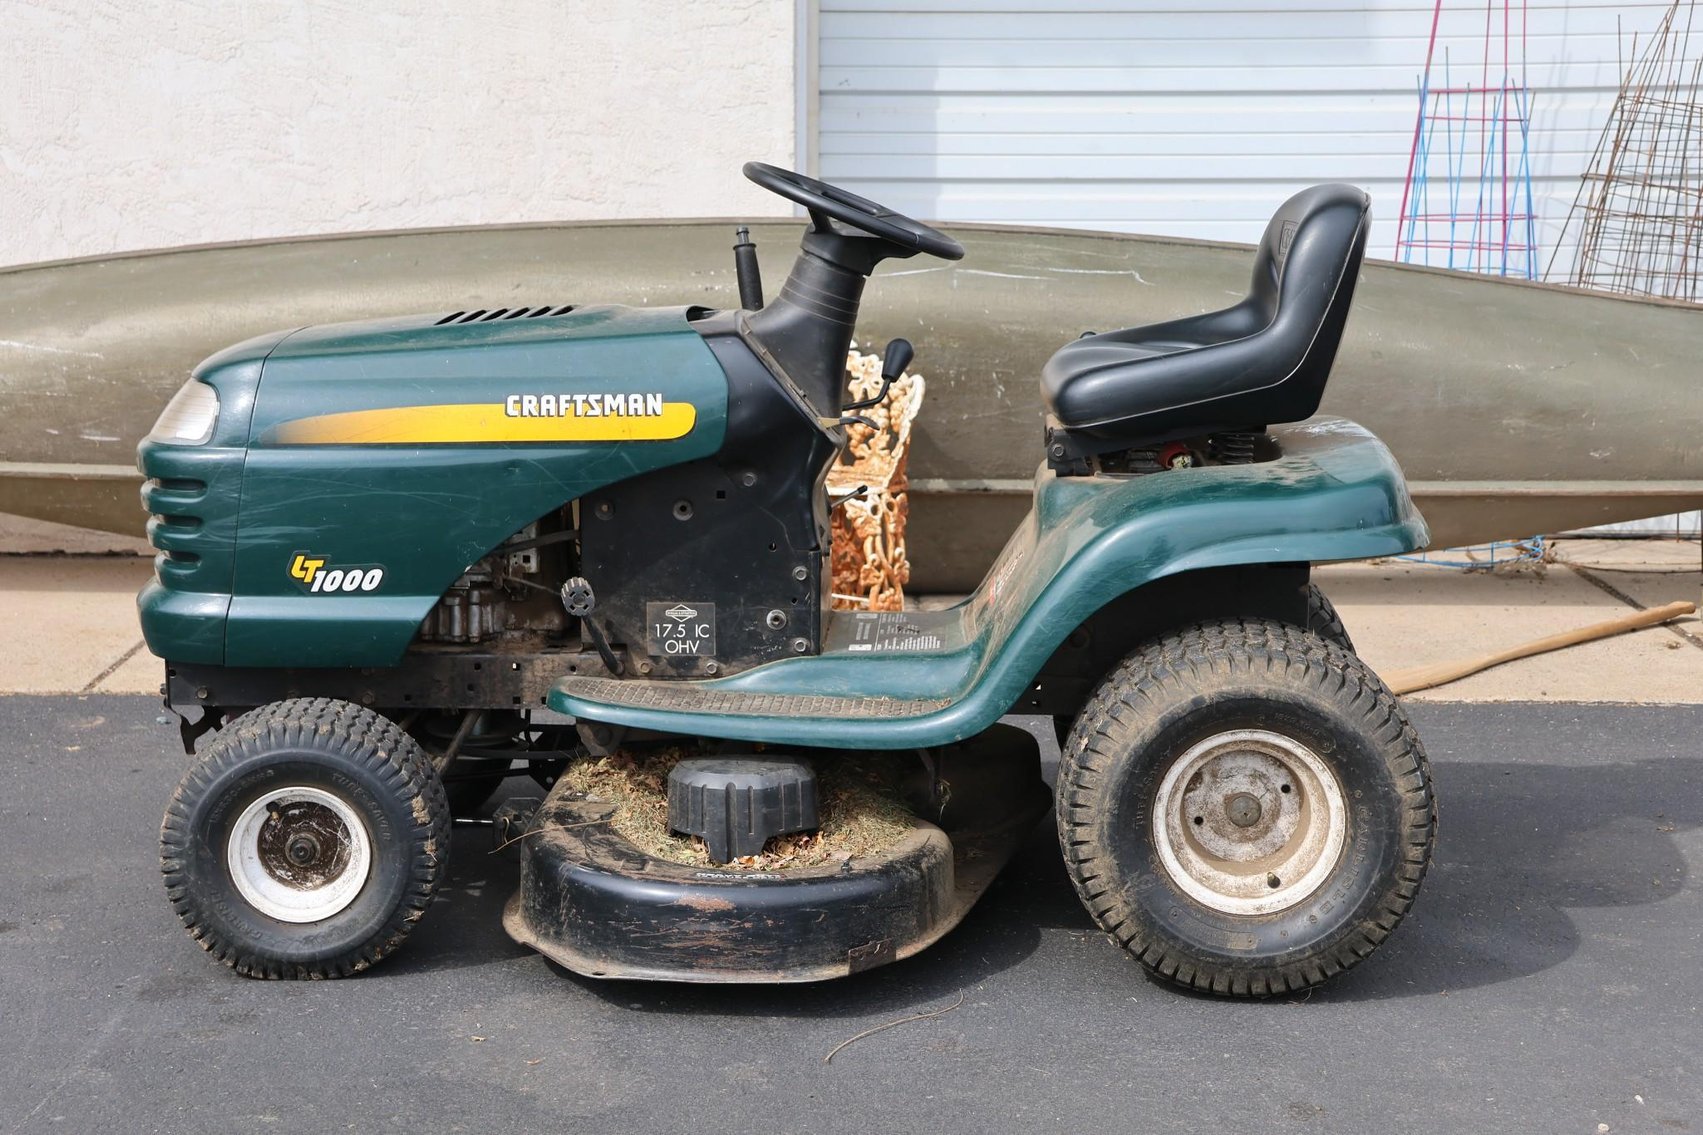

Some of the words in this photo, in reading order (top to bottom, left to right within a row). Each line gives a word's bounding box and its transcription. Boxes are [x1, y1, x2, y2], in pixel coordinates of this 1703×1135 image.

[505, 393, 663, 417] CRAFTSMAN
[655, 623, 686, 638] 17.5
[695, 623, 710, 638] IC
[665, 639, 700, 654] OHV
